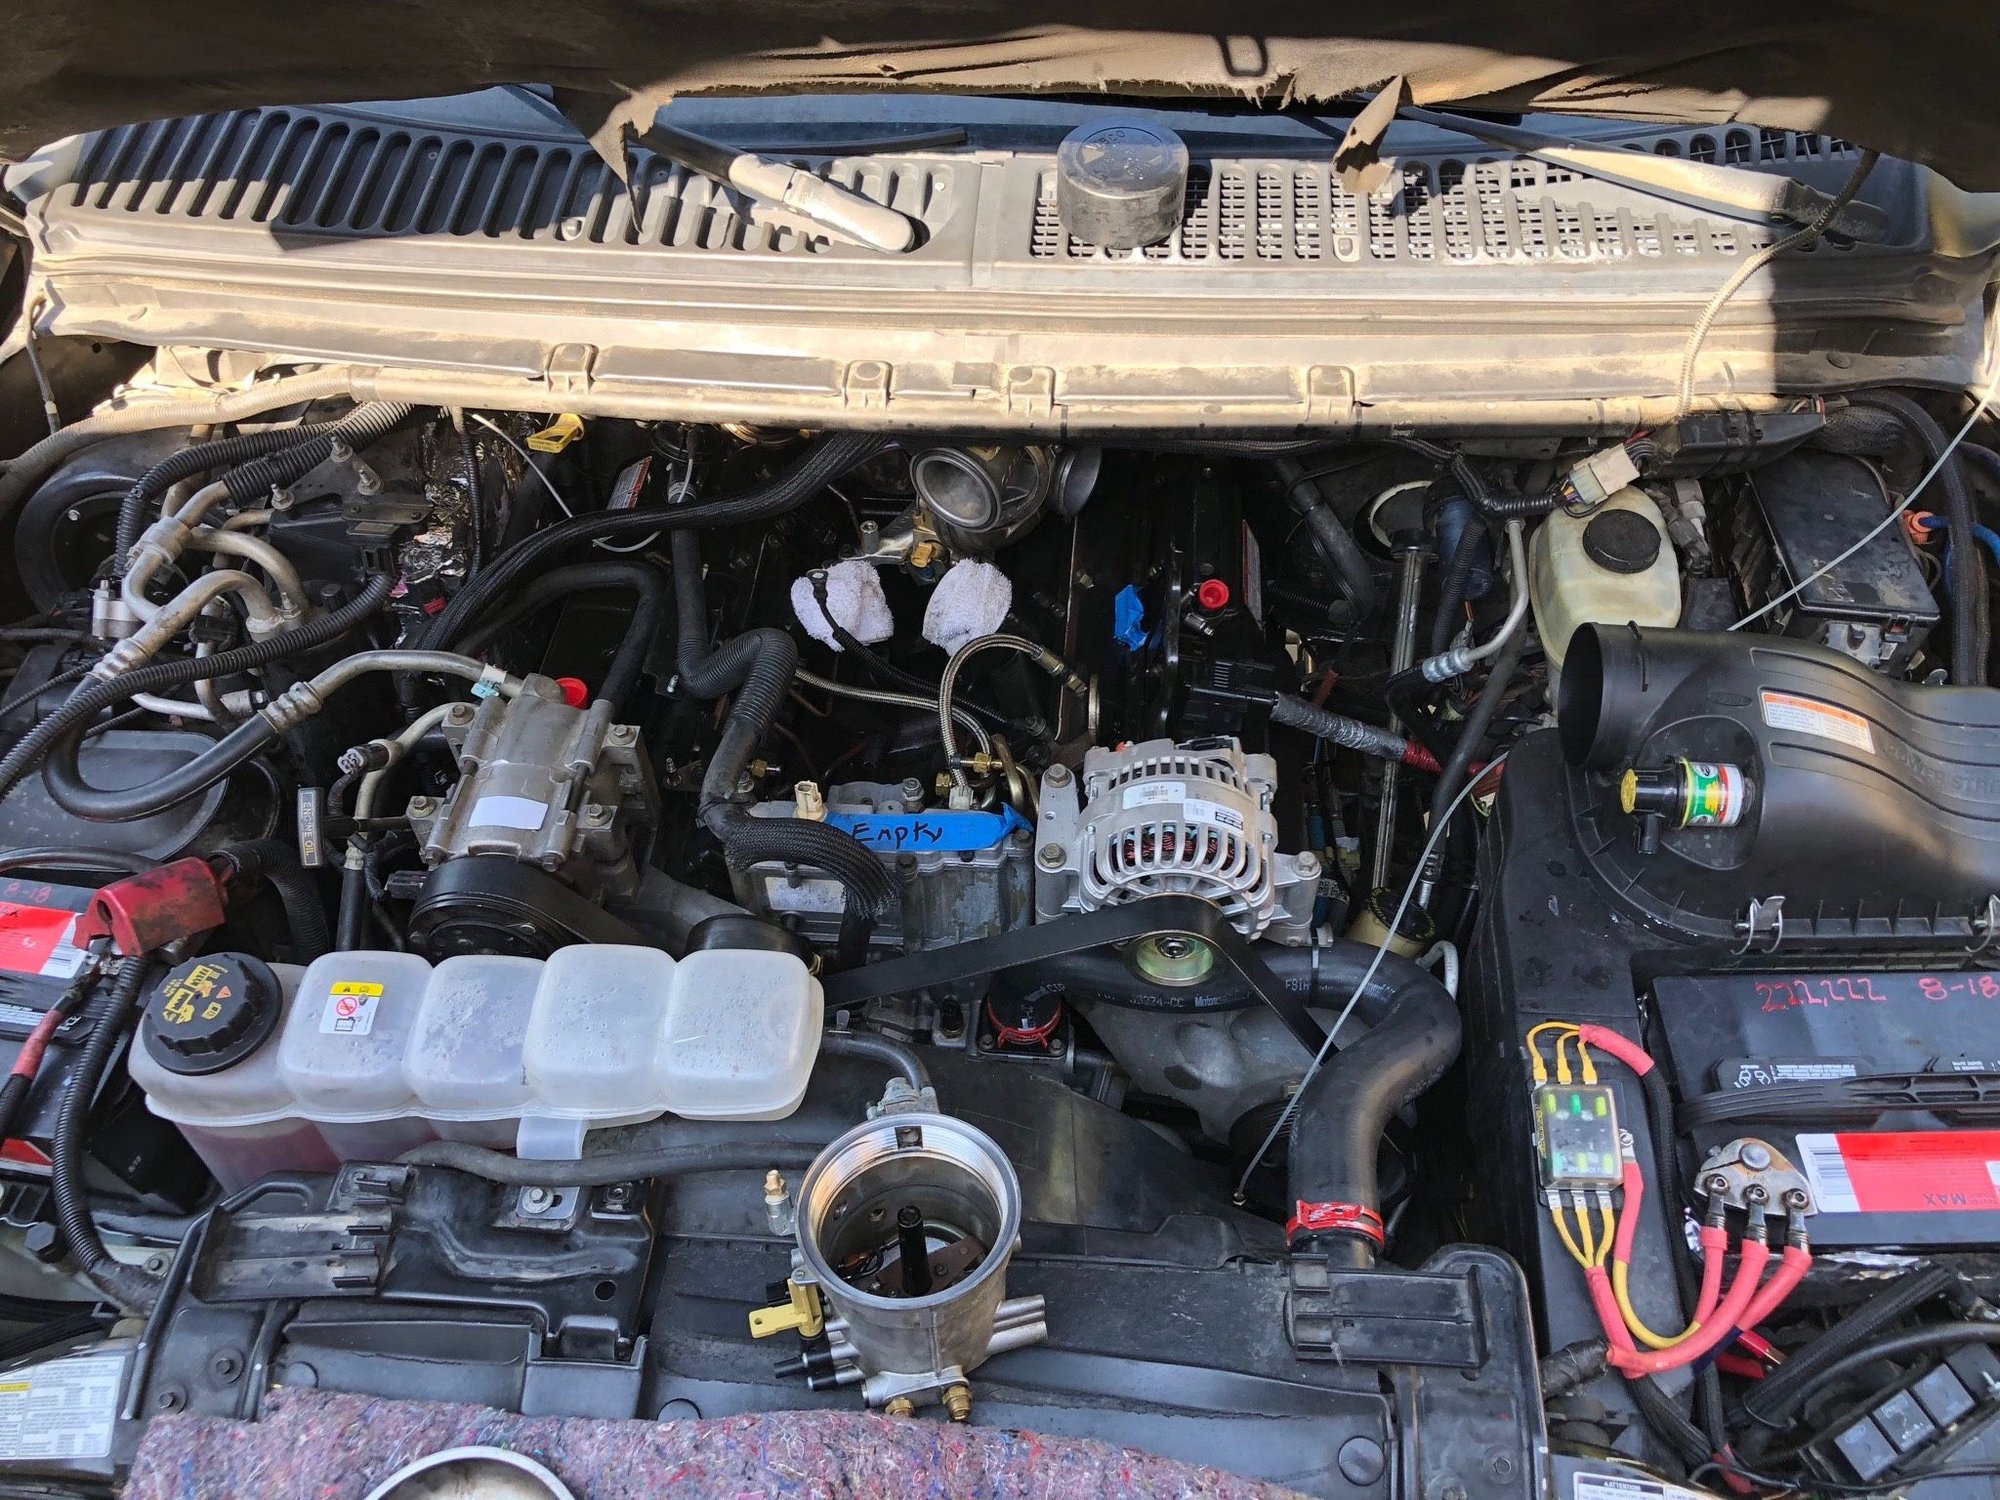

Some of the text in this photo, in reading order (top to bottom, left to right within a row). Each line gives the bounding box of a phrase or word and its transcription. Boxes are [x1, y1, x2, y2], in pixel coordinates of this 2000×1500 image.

[302, 802, 316, 856] ENGINE OIL
[1755, 978, 1887, 1012] 222,222
[1923, 1193, 1968, 1206] MAX
